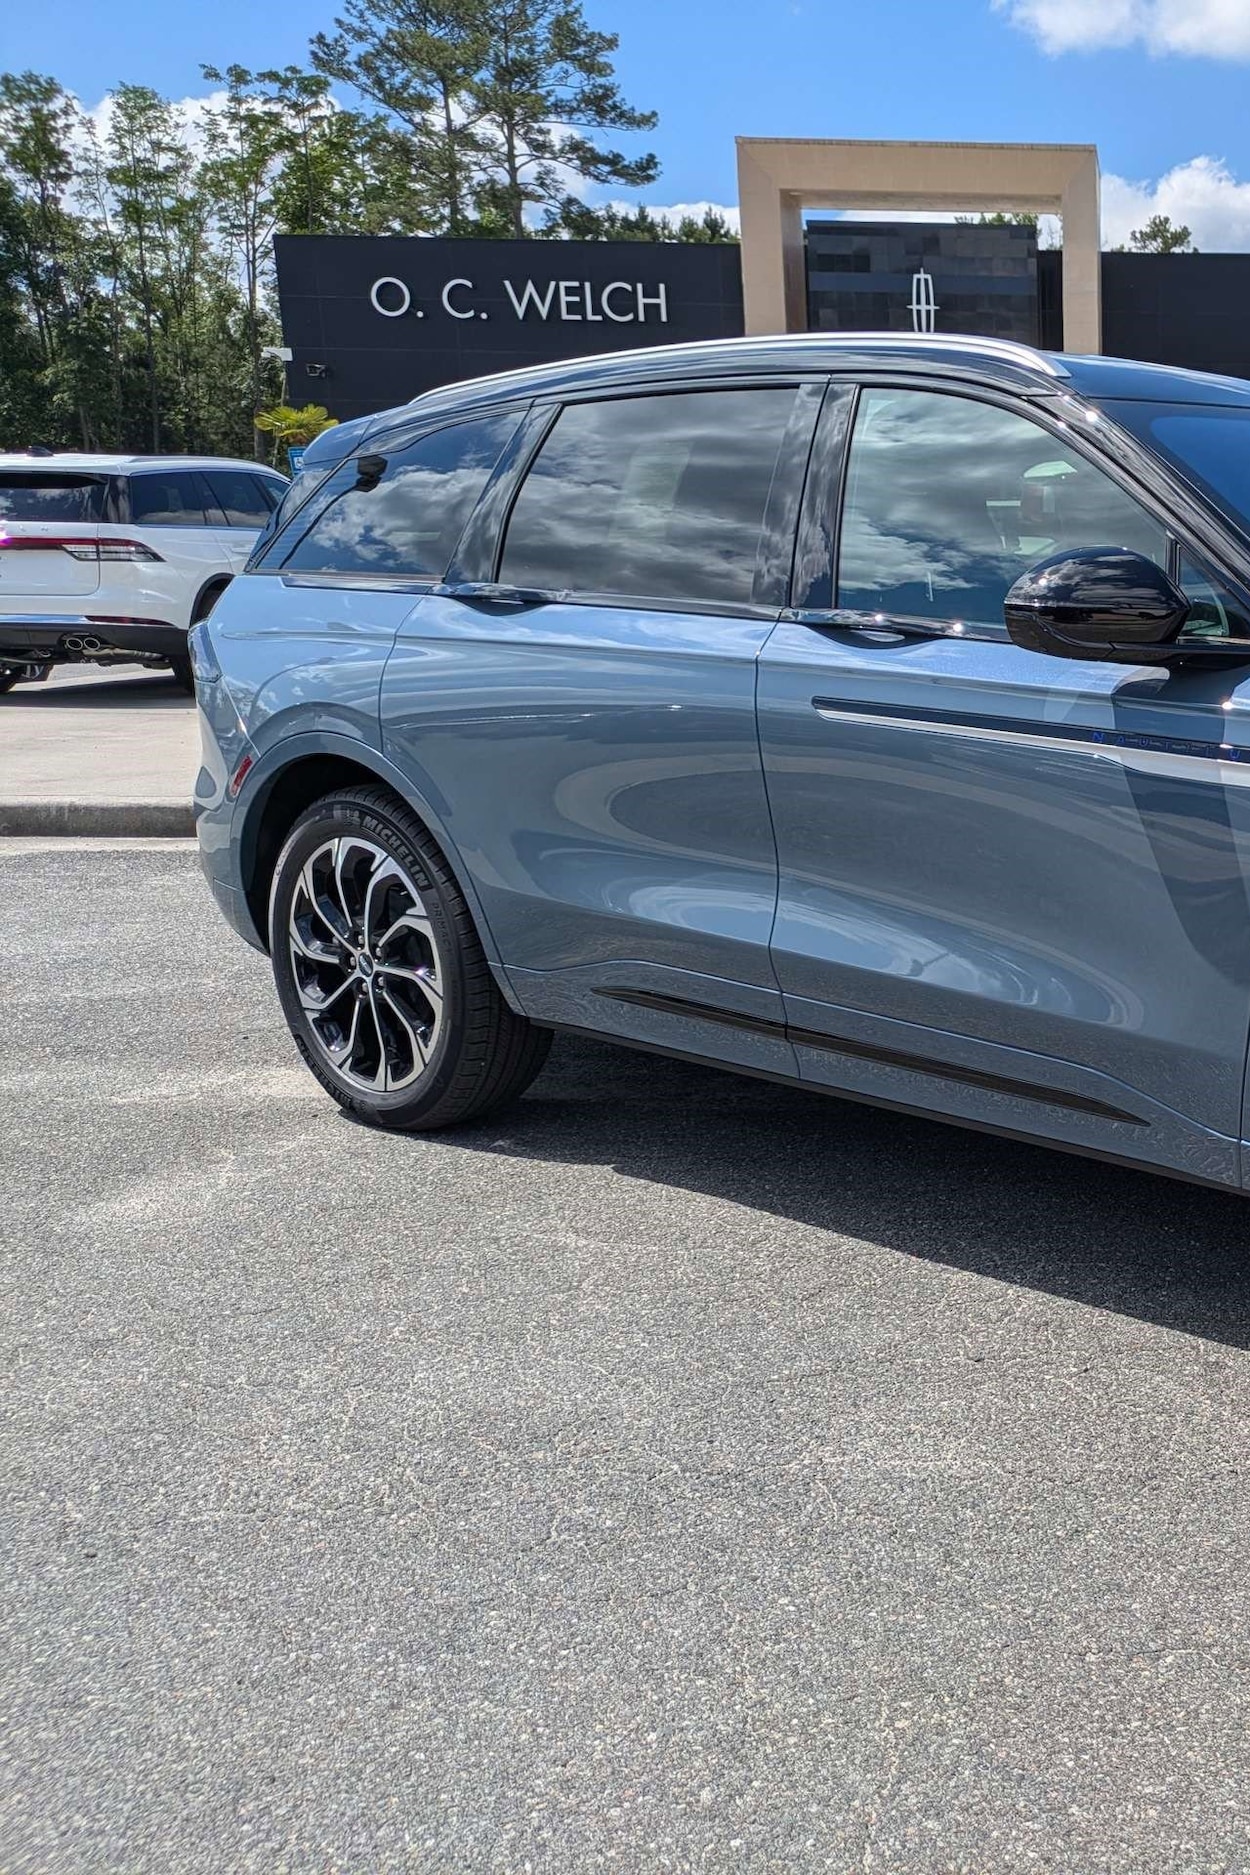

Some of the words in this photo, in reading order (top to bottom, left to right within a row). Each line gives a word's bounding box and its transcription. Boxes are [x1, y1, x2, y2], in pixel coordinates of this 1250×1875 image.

[370, 276, 424, 318] O.
[441, 277, 488, 320] C.
[503, 278, 668, 323] WELCH
[361, 815, 429, 888] MICHELIN
